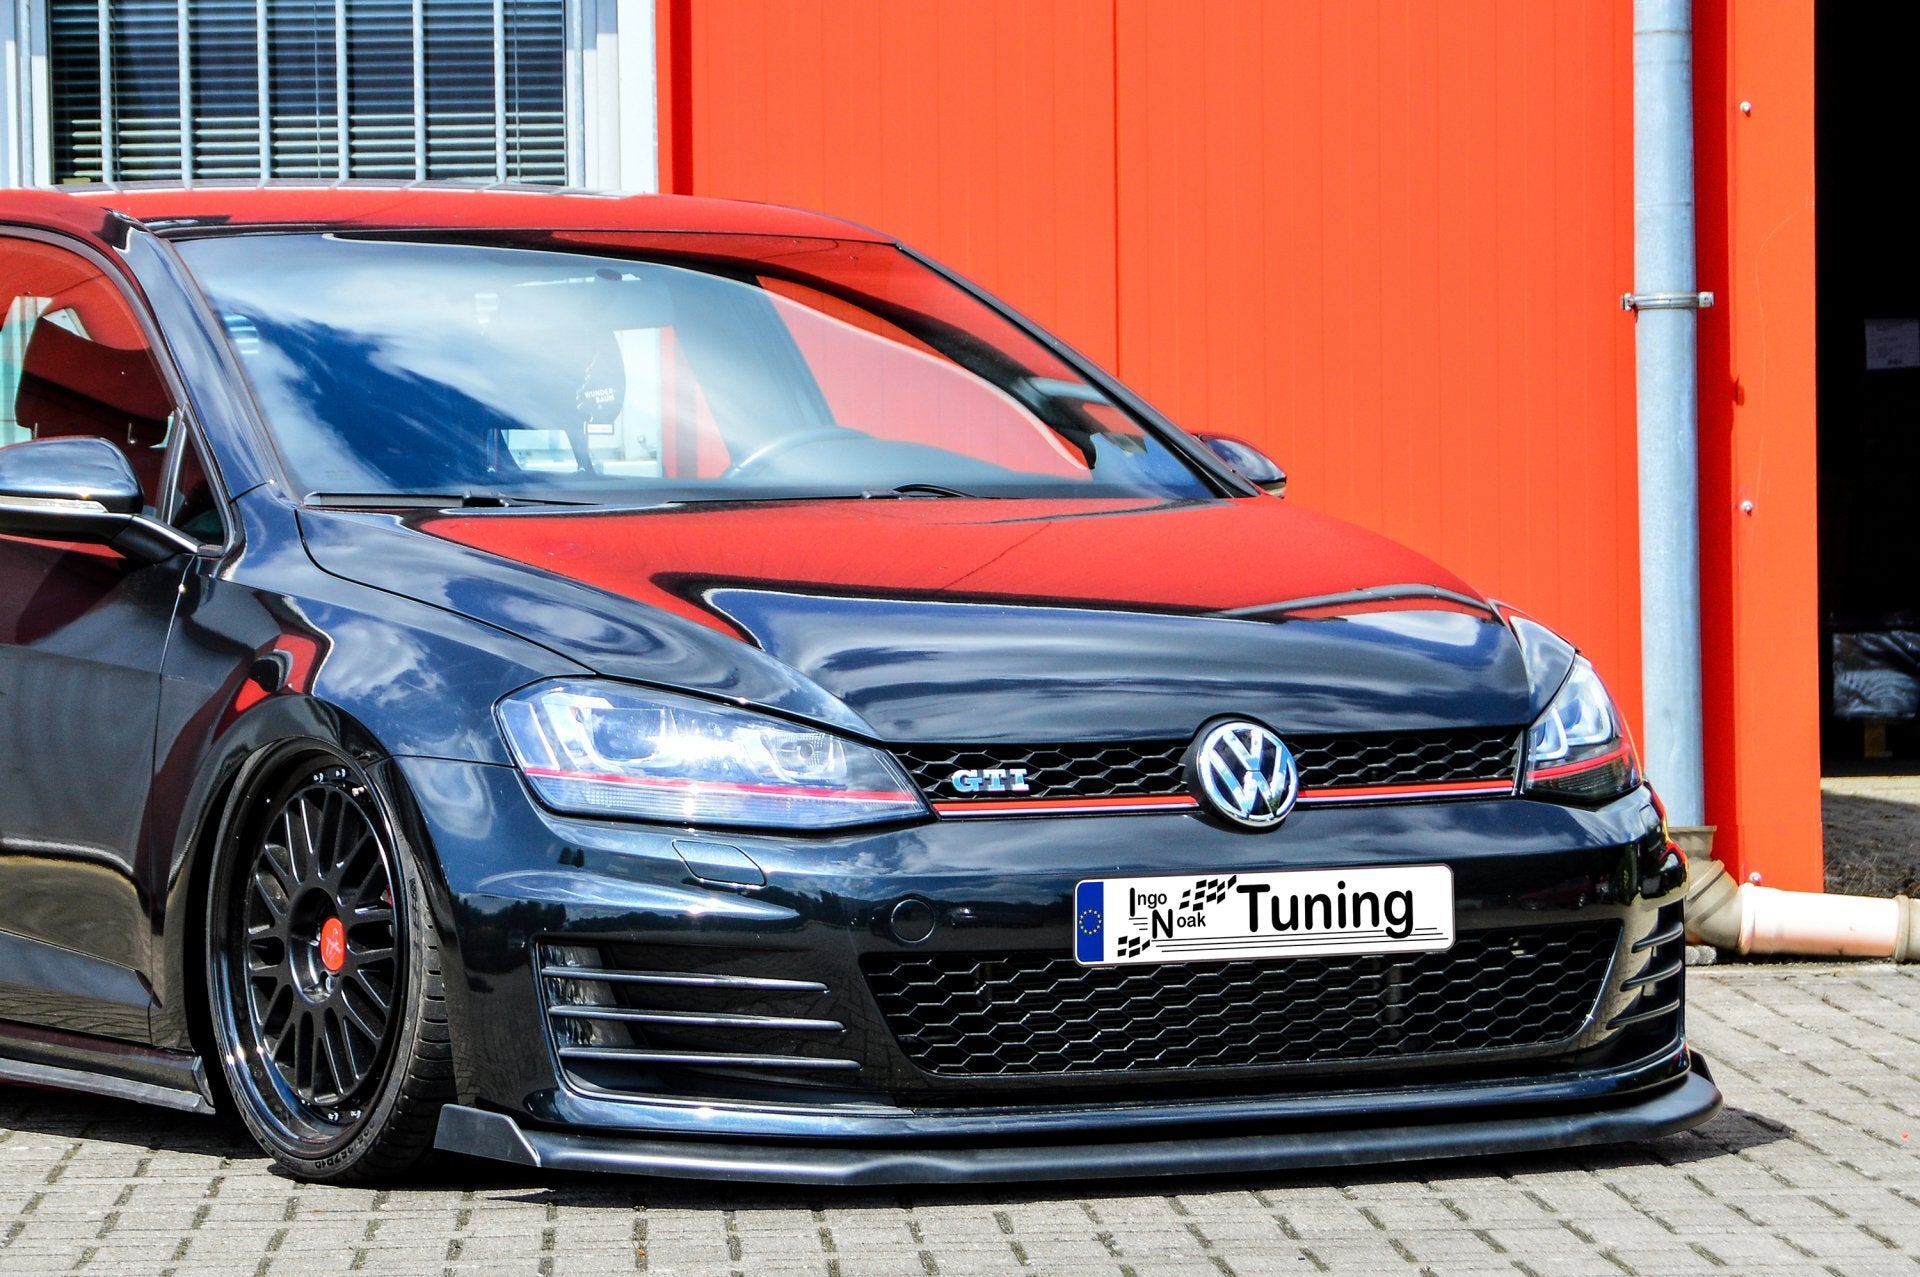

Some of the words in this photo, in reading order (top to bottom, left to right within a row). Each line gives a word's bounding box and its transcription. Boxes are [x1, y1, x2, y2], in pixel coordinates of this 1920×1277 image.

[952, 768, 1031, 793] GTI
[1198, 722, 1299, 827] VW
[1129, 887, 1168, 917] Ingo
[1236, 880, 1415, 939] Tuning
[1151, 908, 1207, 939] Noak
